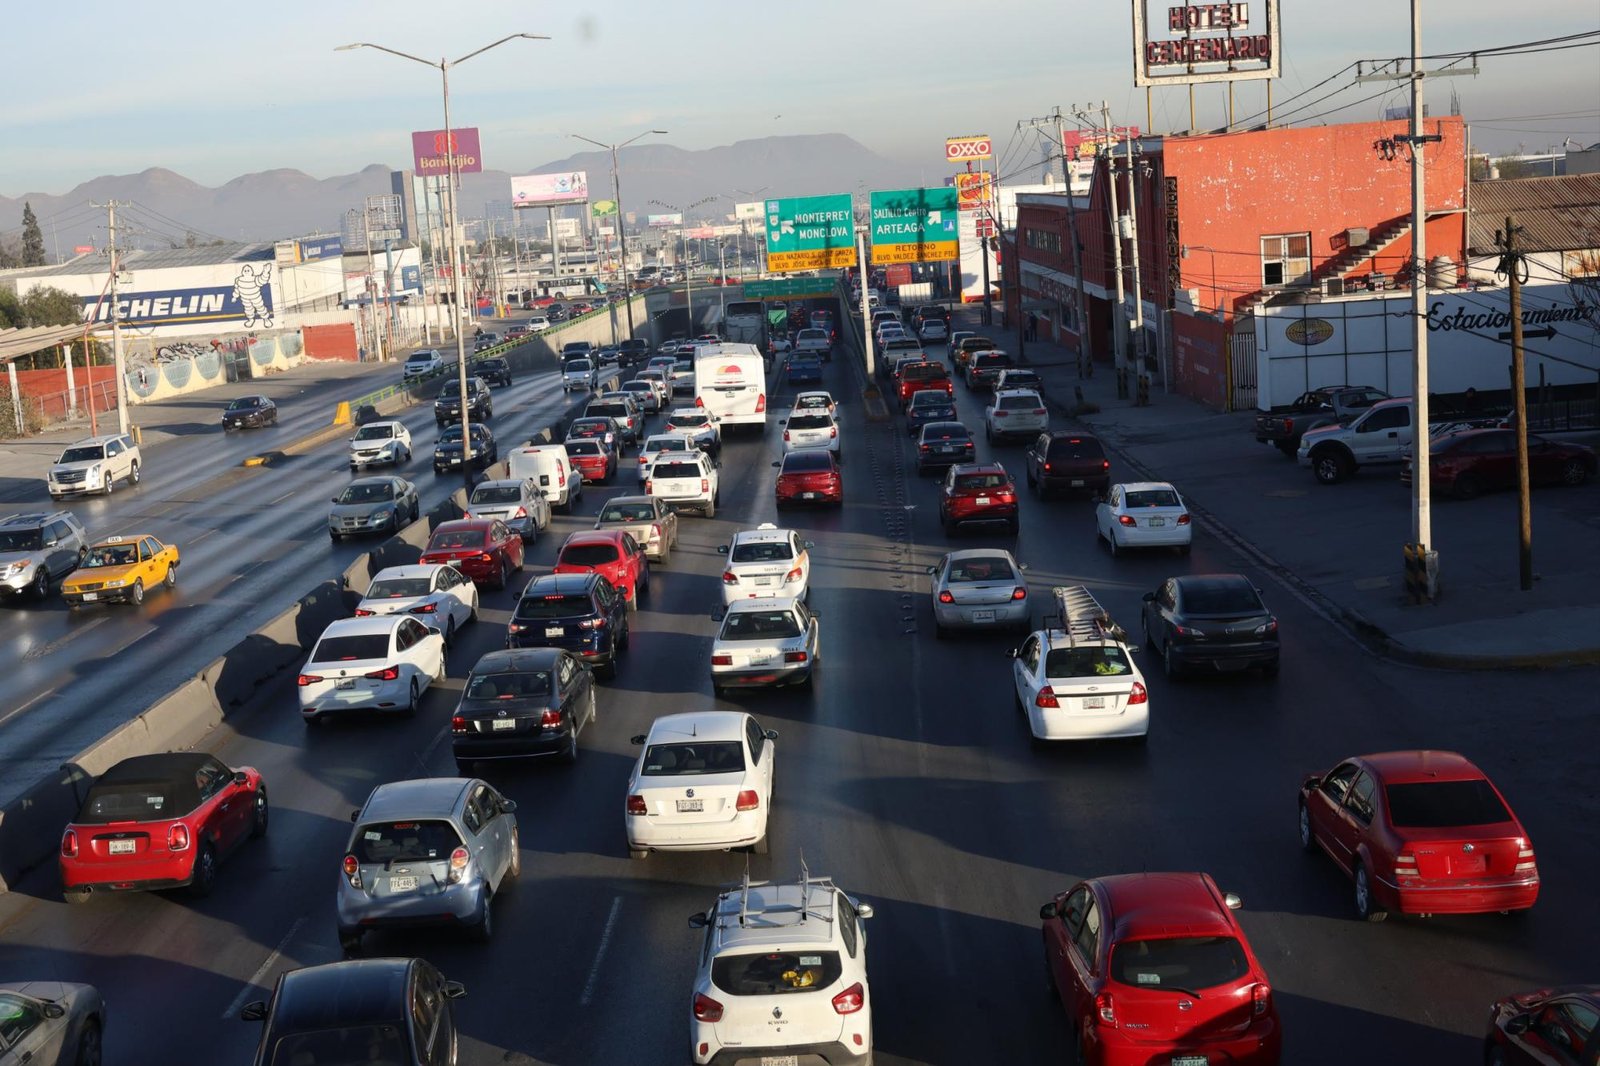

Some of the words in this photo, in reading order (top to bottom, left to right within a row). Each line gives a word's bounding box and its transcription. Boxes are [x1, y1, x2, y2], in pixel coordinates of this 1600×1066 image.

[1169, 3, 1249, 30] HOTEL
[1147, 35, 1269, 63] CENTENARIO
[948, 141, 989, 157] OXXO
[794, 210, 849, 224] MONTERREY
[873, 208, 902, 219] SALTILLO
[904, 207, 927, 217] Centro
[799, 226, 848, 239] MONCLOVA
[876, 222, 925, 235] ARTEAGA
[895, 243, 936, 252] RETORNO
[82, 293, 226, 321] MICHELIN
